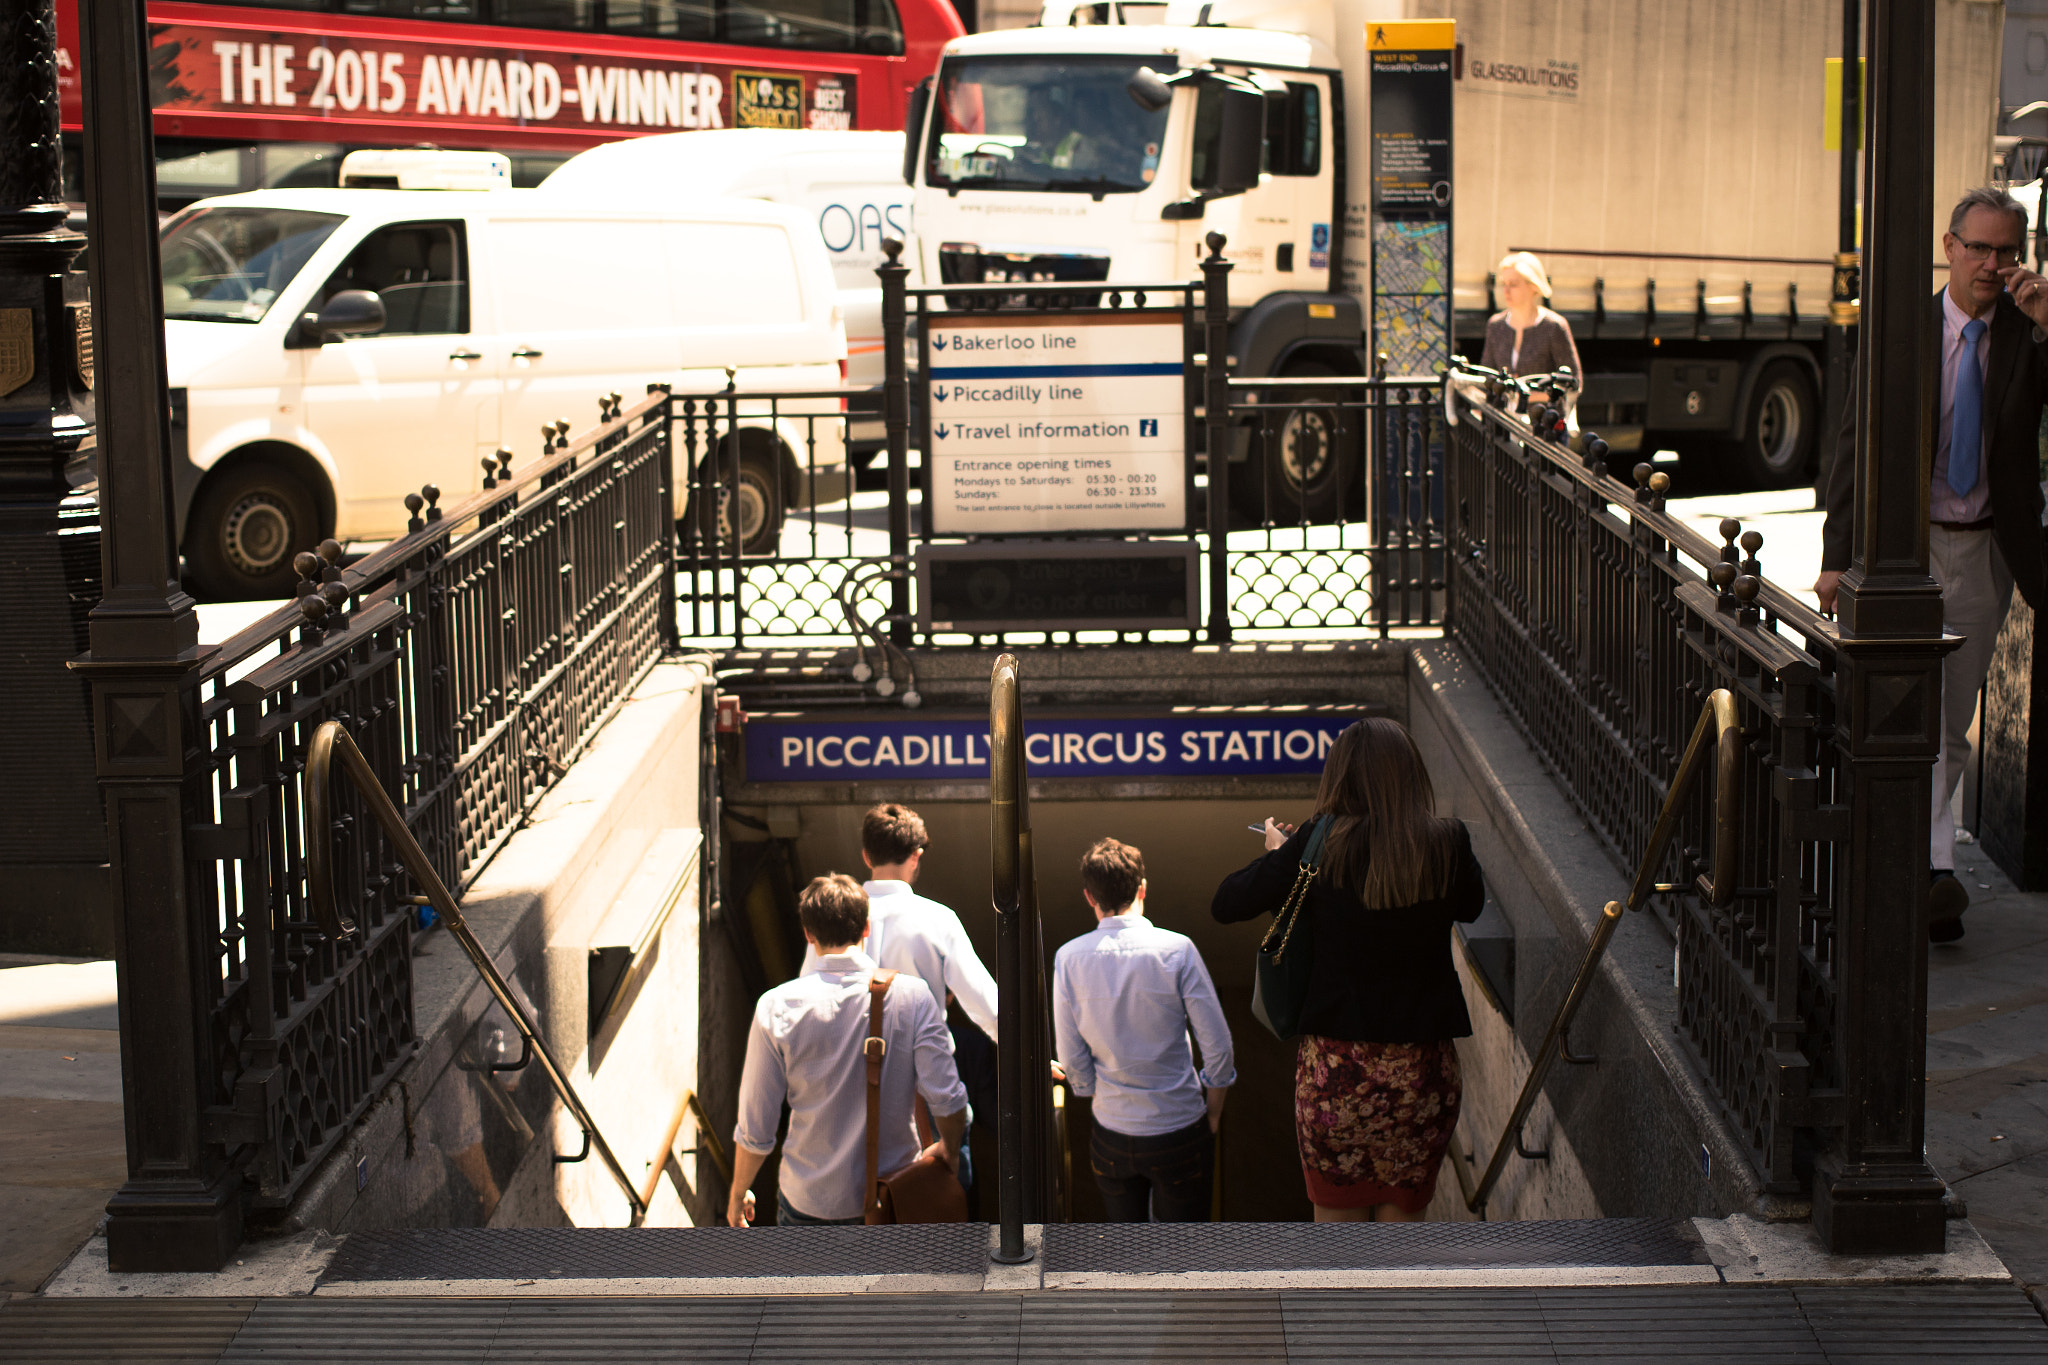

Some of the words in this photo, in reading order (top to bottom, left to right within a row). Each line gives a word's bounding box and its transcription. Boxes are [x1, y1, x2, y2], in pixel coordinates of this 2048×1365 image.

[1374, 54, 1398, 63] WEST
[1399, 54, 1418, 63] END
[212, 40, 297, 107] THE
[307, 45, 407, 113] 2015
[416, 54, 724, 129] AWARD-WINNER
[1471, 60, 1579, 91] GLASSOLUTIONS
[738, 77, 798, 109] Miss
[813, 88, 846, 110] BEST
[952, 334, 1035, 350] Bakerloo
[1042, 333, 1077, 349] line
[953, 385, 1042, 404] Piccadilly
[1049, 384, 1083, 400] line
[953, 422, 1011, 439] Travel
[1018, 421, 1130, 438] information
[954, 459, 1012, 471] Entrance
[1017, 458, 1070, 472] opening
[1074, 457, 1112, 469] times
[954, 476, 1000, 487] Mondays
[1004, 477, 1016, 485] to
[1020, 475, 1074, 486] Saturdays:
[1086, 474, 1116, 484] 05:30
[1127, 473, 1157, 483] 00:20
[1086, 487, 1117, 497] 06:30
[1128, 486, 1157, 496] 23:35
[956, 504, 969, 512] The
[971, 504, 985, 512] last
[1064, 502, 1092, 510] located
[1095, 502, 1122, 510] outside
[1125, 501, 1166, 510] Lillywhites
[781, 733, 990, 768] PICCADILL
[1025, 731, 1167, 764] CIRCUS
